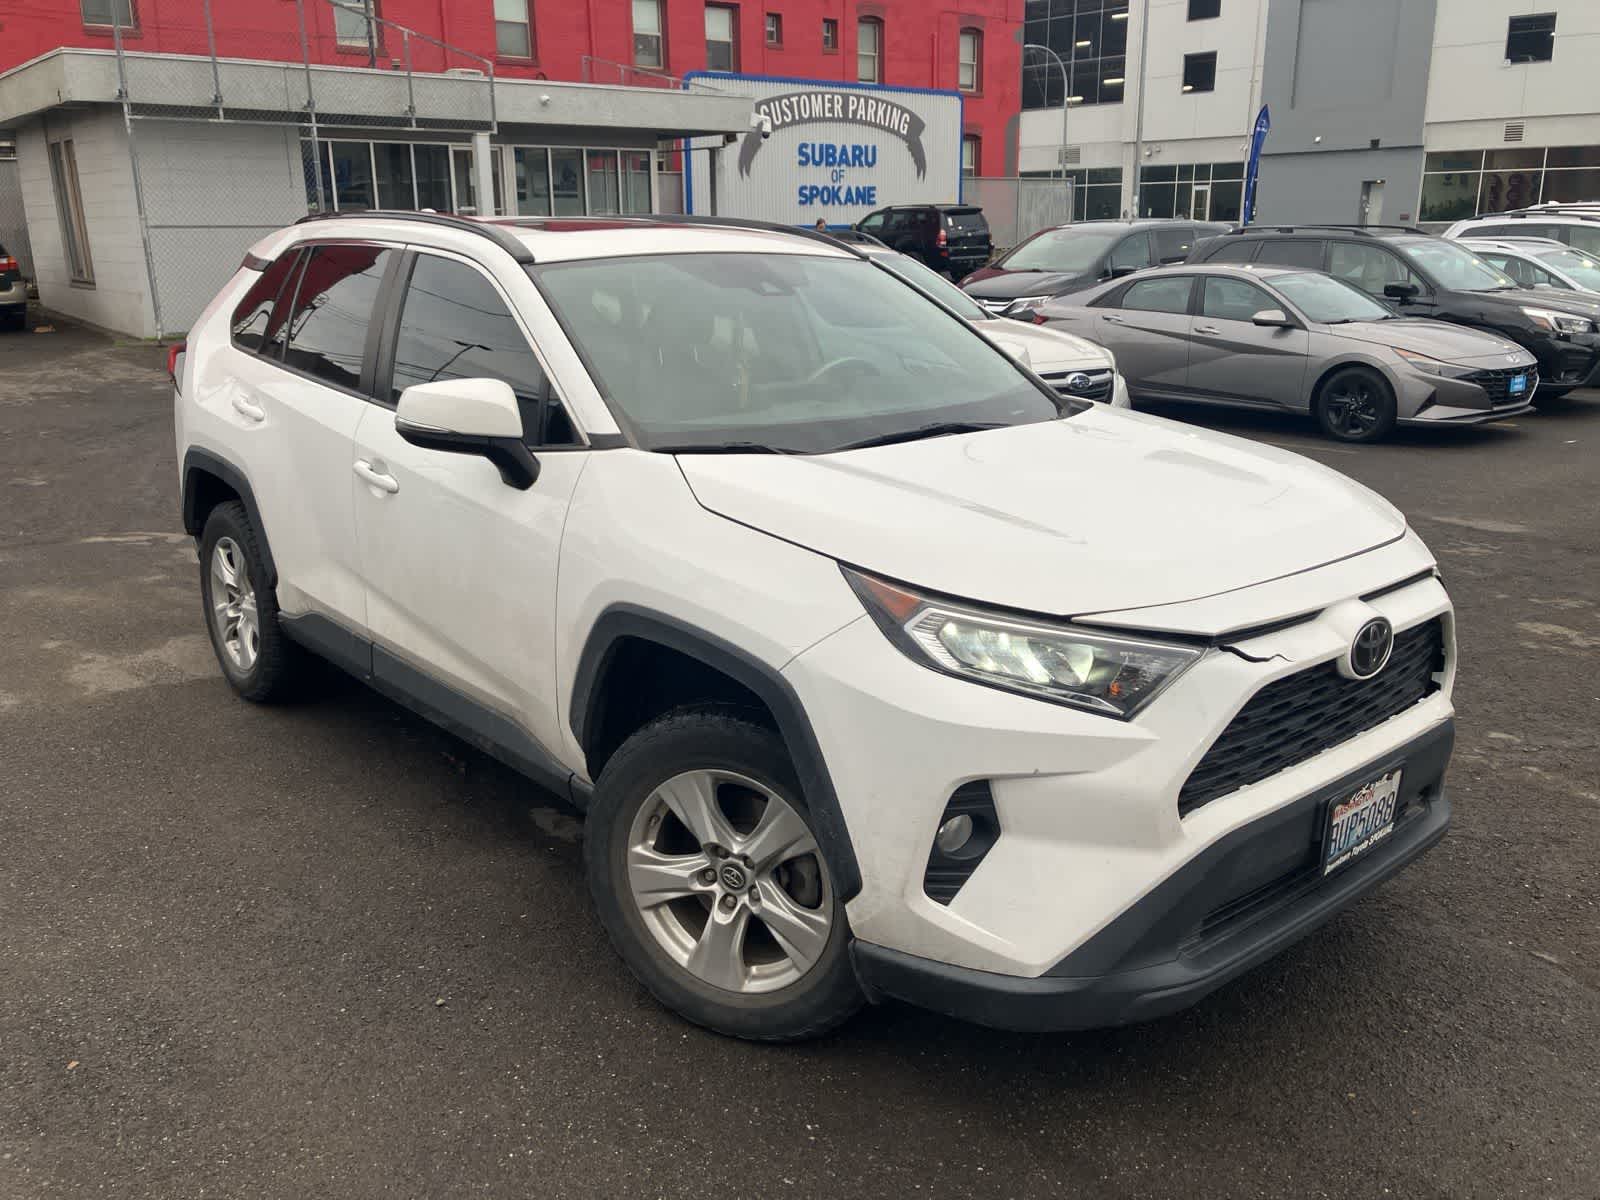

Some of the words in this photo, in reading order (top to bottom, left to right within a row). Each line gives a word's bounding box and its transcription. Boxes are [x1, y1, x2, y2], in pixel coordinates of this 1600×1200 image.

[848, 94, 910, 135] PARKING
[798, 143, 877, 167] SUBARU
[831, 169, 845, 184] OF
[798, 185, 877, 206] SPOKANE
[1328, 791, 1396, 858] BUP5088
